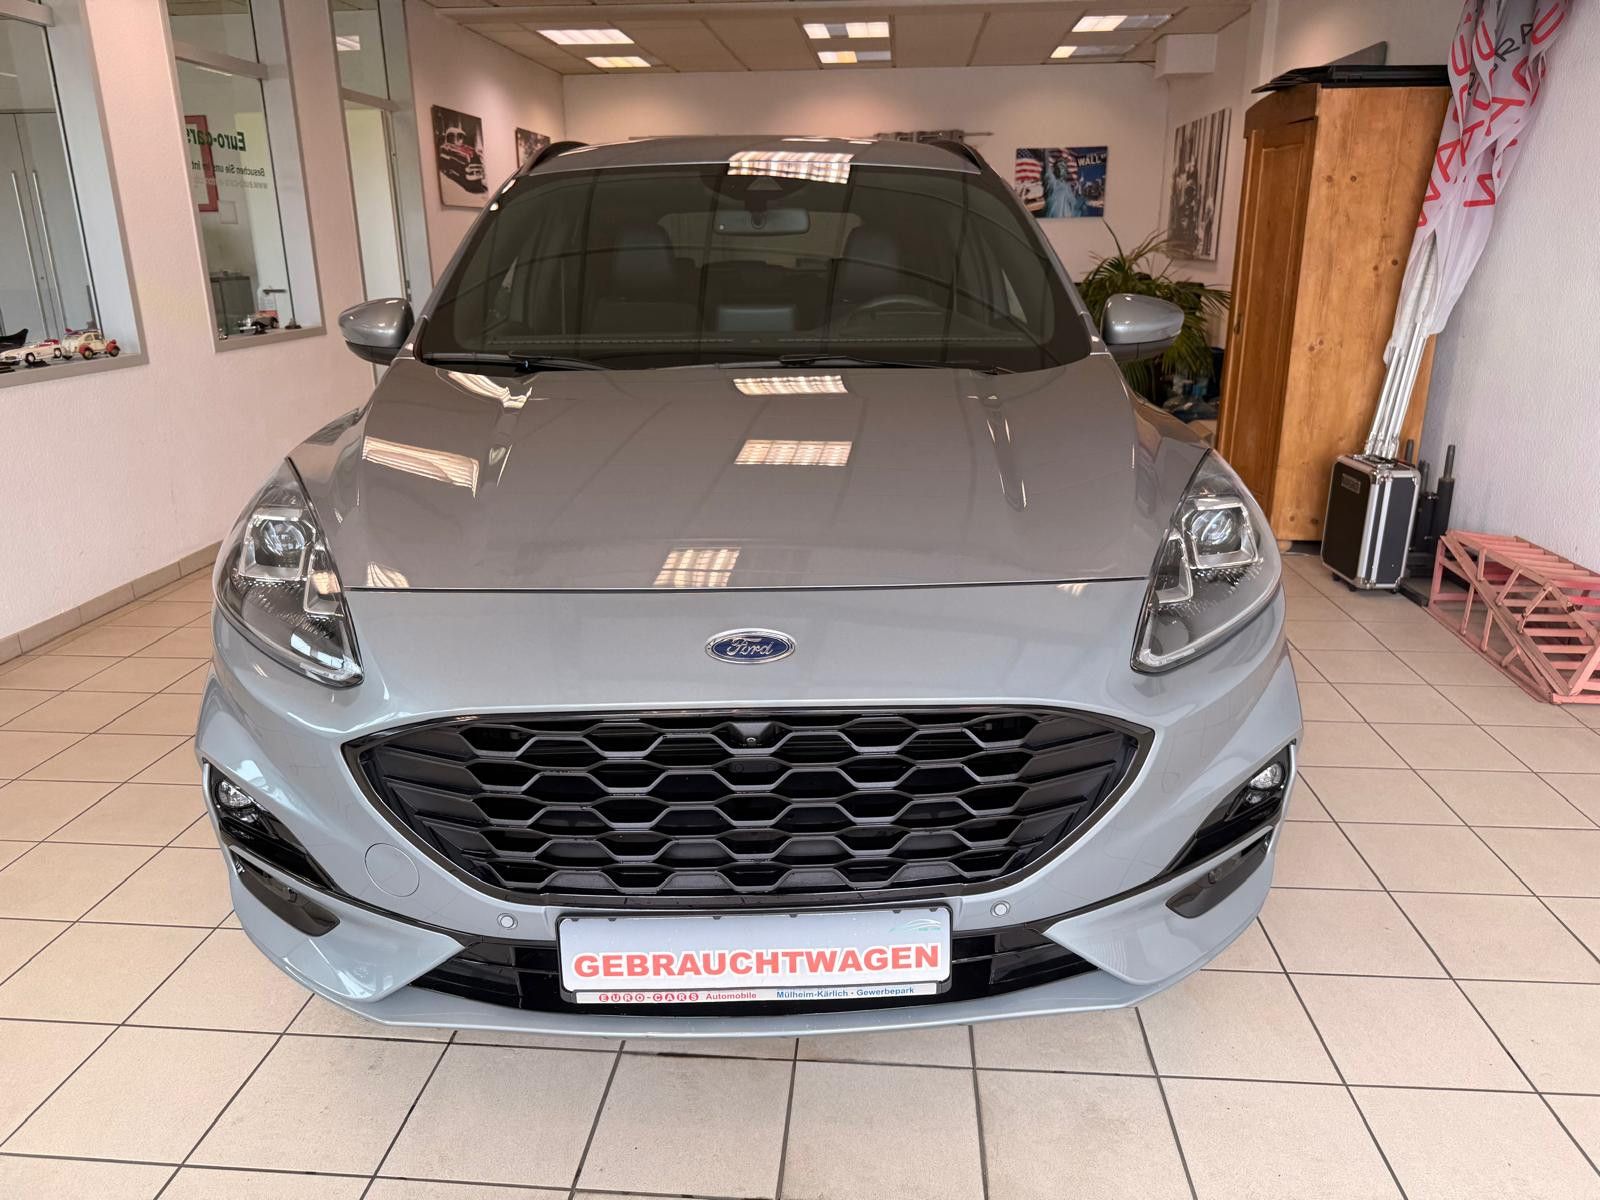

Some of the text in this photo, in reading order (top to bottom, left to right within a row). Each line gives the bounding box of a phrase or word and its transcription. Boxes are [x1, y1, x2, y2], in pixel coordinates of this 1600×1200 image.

[726, 637, 775, 656] Ford
[573, 944, 940, 978] GEBRAUCHTWAGEN
[598, 987, 914, 1003] EURO-CARS Automobile Mülheim-Kärlich Gewerbepark
